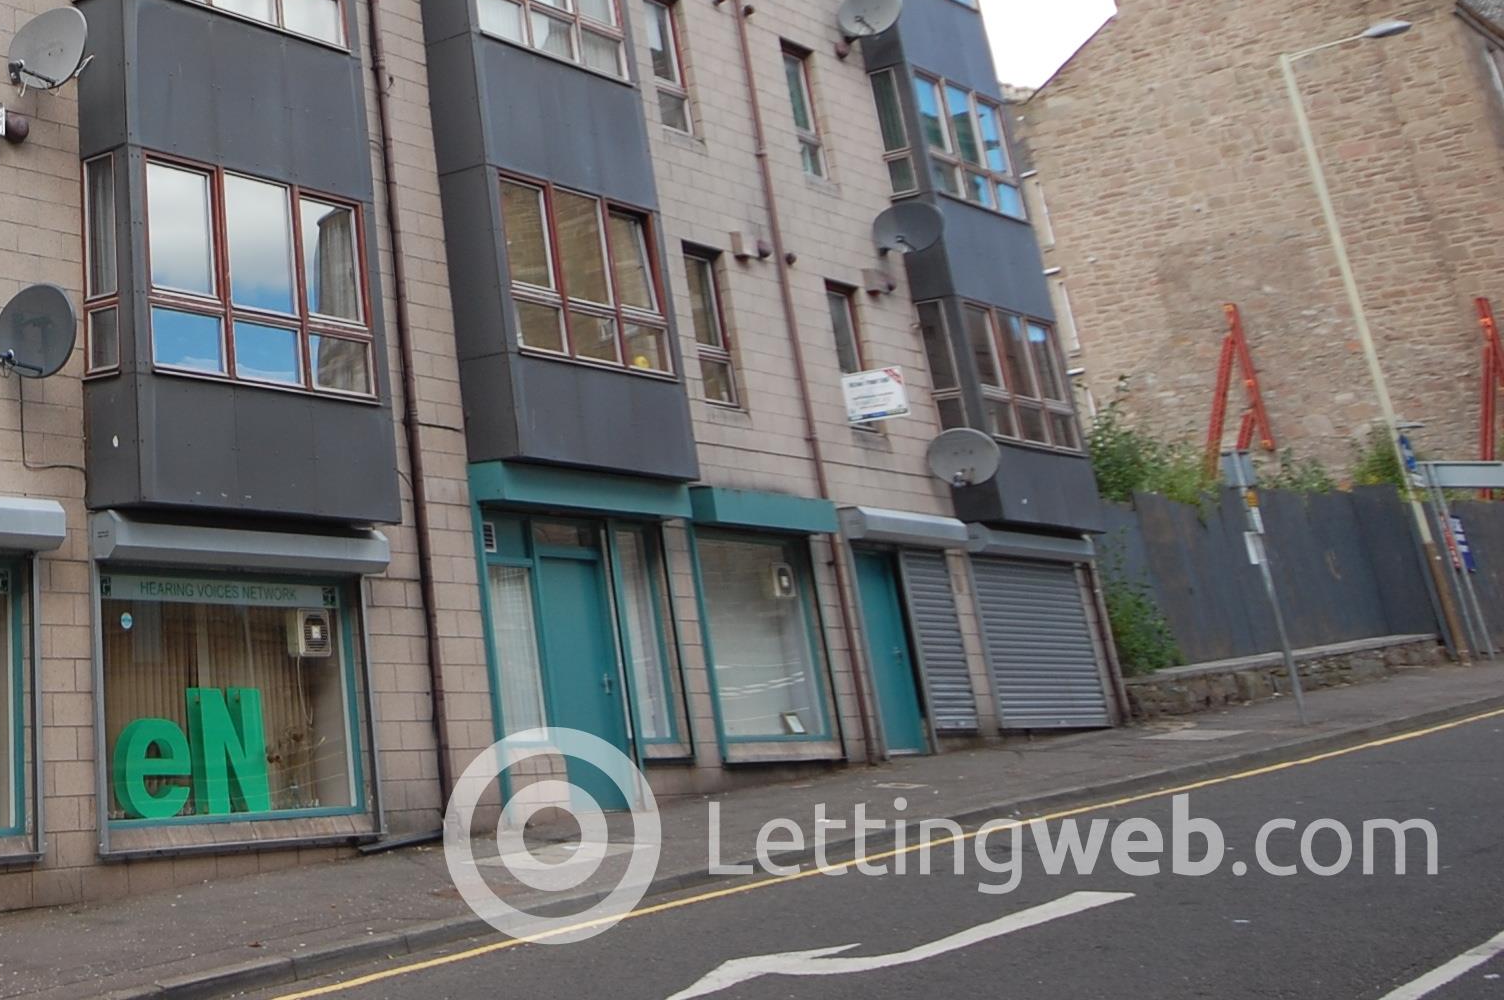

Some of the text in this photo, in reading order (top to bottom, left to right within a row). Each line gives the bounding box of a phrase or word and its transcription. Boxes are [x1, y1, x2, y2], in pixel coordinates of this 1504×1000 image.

[140, 581, 296, 601] HEARING VOICES NETWORK
